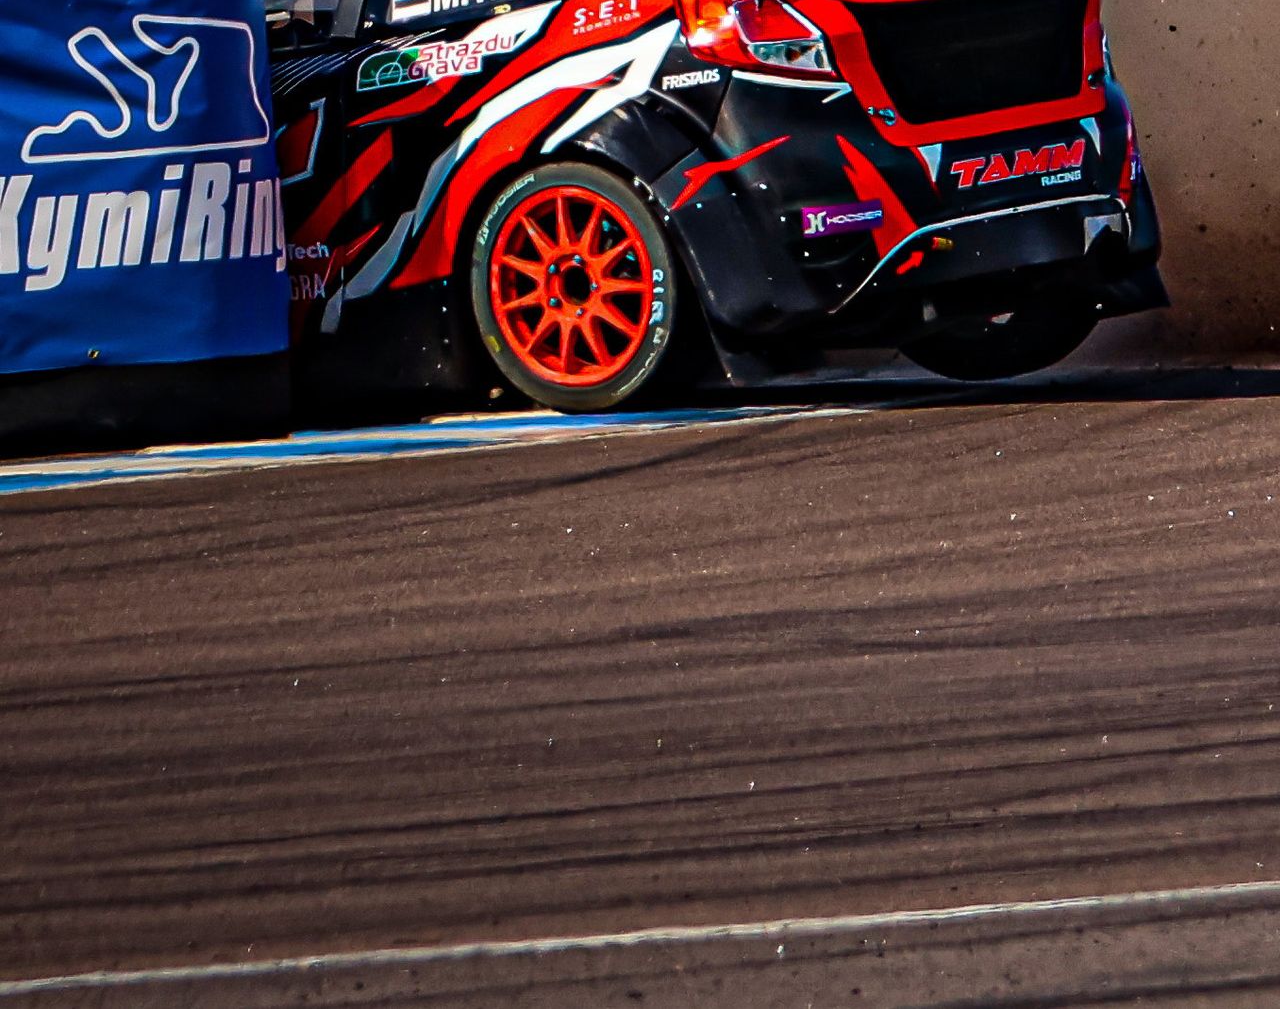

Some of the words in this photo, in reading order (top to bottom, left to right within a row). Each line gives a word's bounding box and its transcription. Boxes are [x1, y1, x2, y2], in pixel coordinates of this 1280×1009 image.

[572, 11, 641, 36] PROMOTION
[418, 33, 514, 62] Strazdu
[407, 54, 480, 81] Grava
[661, 68, 721, 91] FRISTADS
[951, 138, 1086, 189] TAMM
[1041, 169, 1082, 187] RACING
[826, 209, 883, 226] HOOSIER
